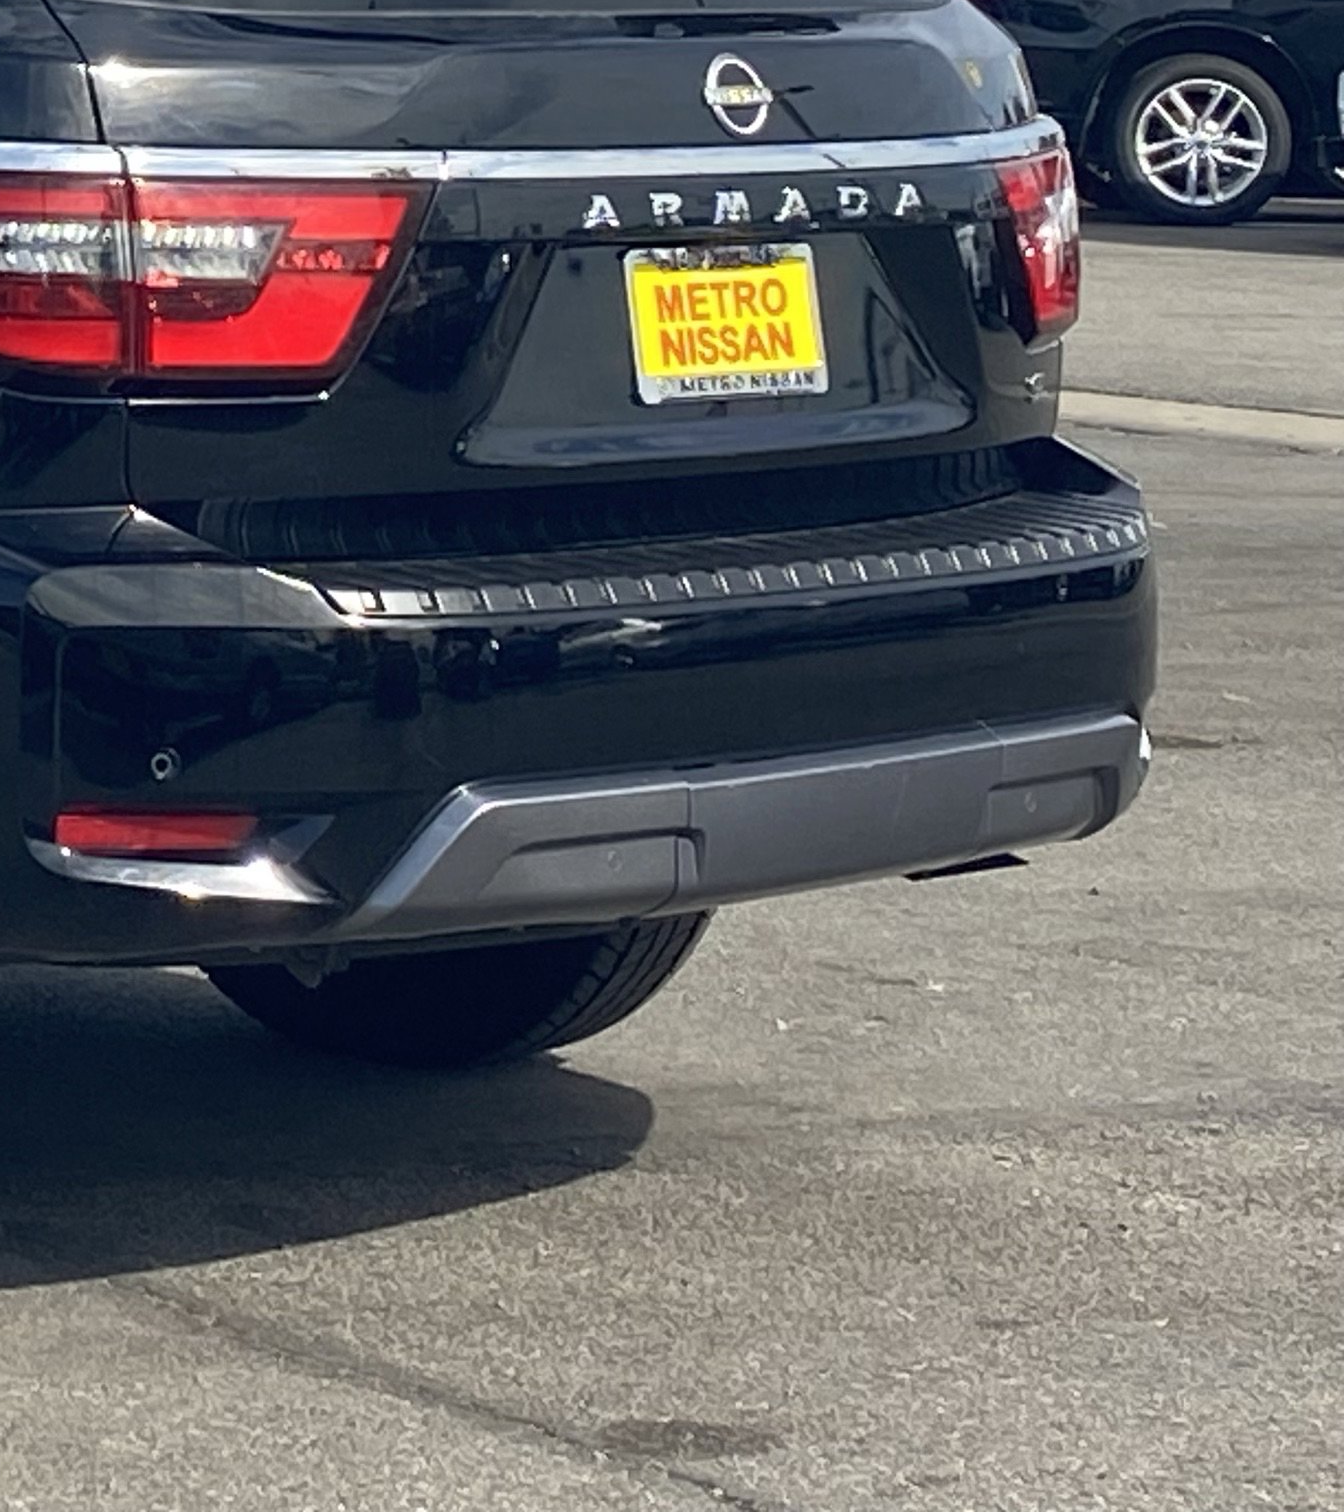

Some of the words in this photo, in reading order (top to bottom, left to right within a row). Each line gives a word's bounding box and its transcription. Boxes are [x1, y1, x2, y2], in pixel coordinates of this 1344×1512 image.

[582, 183, 927, 229] ARMADA
[654, 278, 788, 323] METRO
[659, 322, 796, 367] NISSAN
[680, 375, 745, 392] METRO
[750, 371, 815, 388] NISSAN
